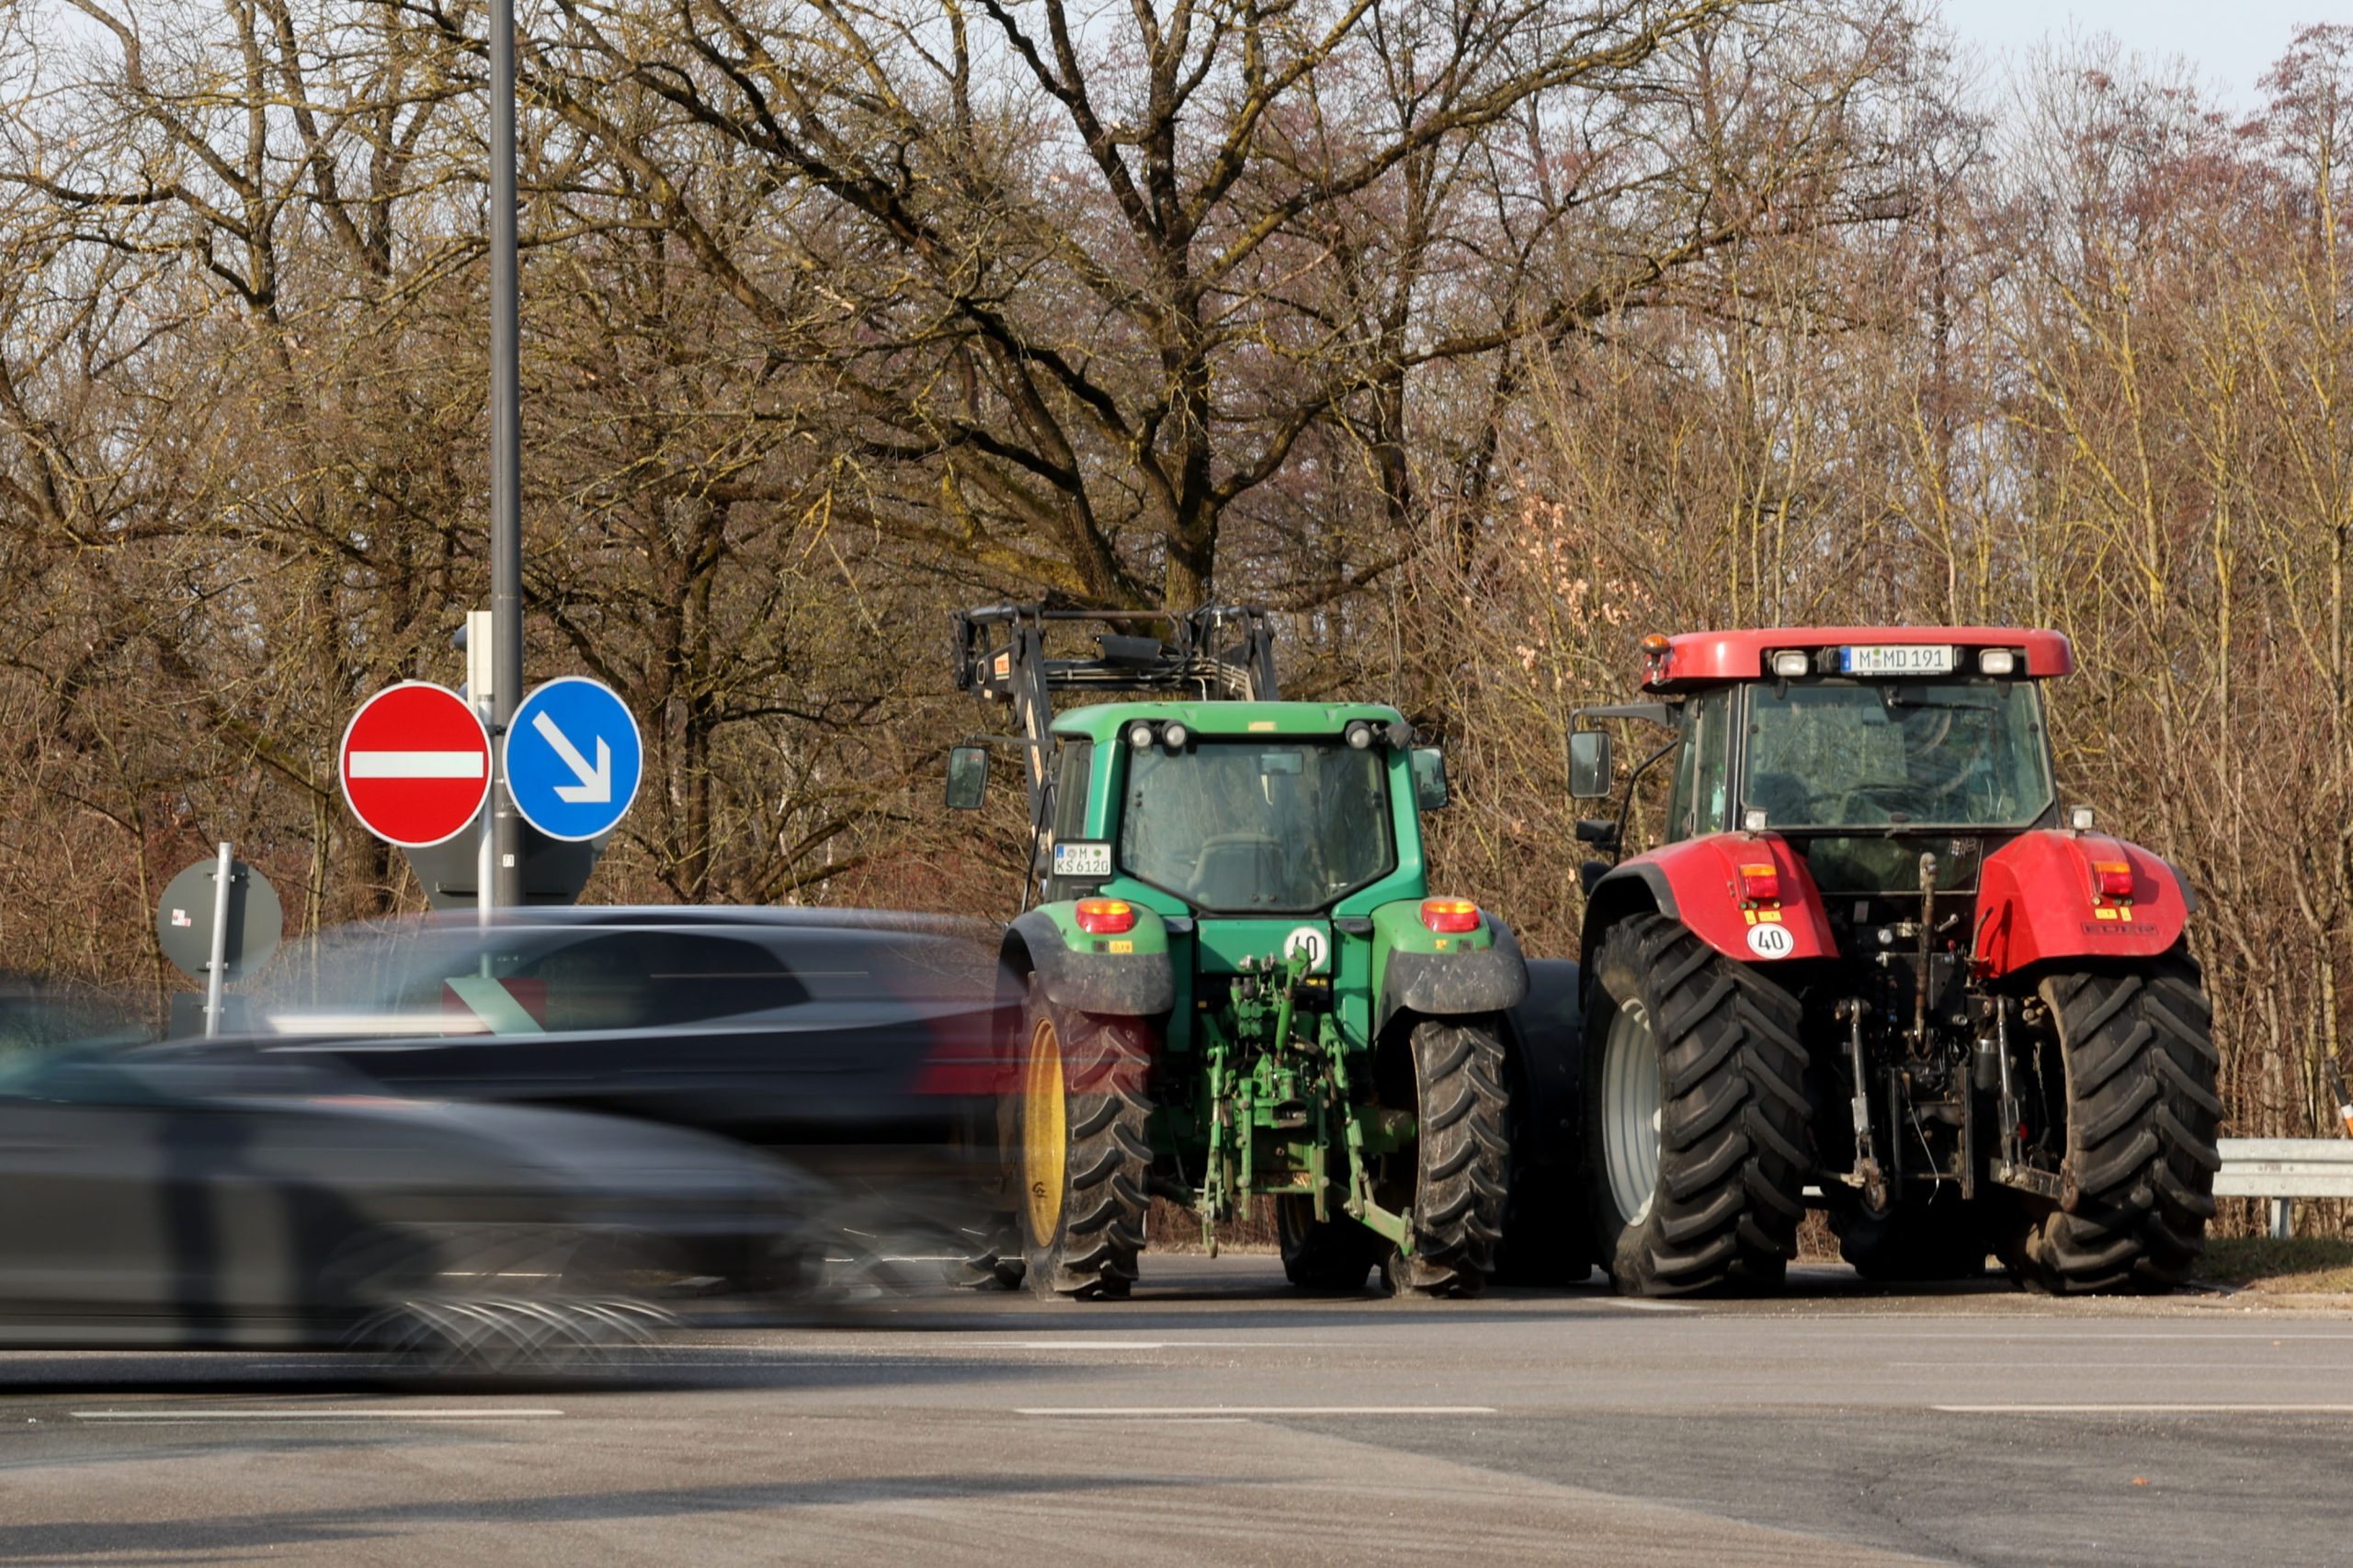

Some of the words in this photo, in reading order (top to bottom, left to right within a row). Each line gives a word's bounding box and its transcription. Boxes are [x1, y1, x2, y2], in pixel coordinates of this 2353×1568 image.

[1859, 649, 1870, 668] M
[1883, 649, 1906, 668] MD
[1912, 649, 1944, 667] 191
[1079, 846, 1087, 858] M
[1057, 860, 1074, 873] KS
[1076, 860, 1108, 873] 6120
[1758, 930, 1784, 950] 40
